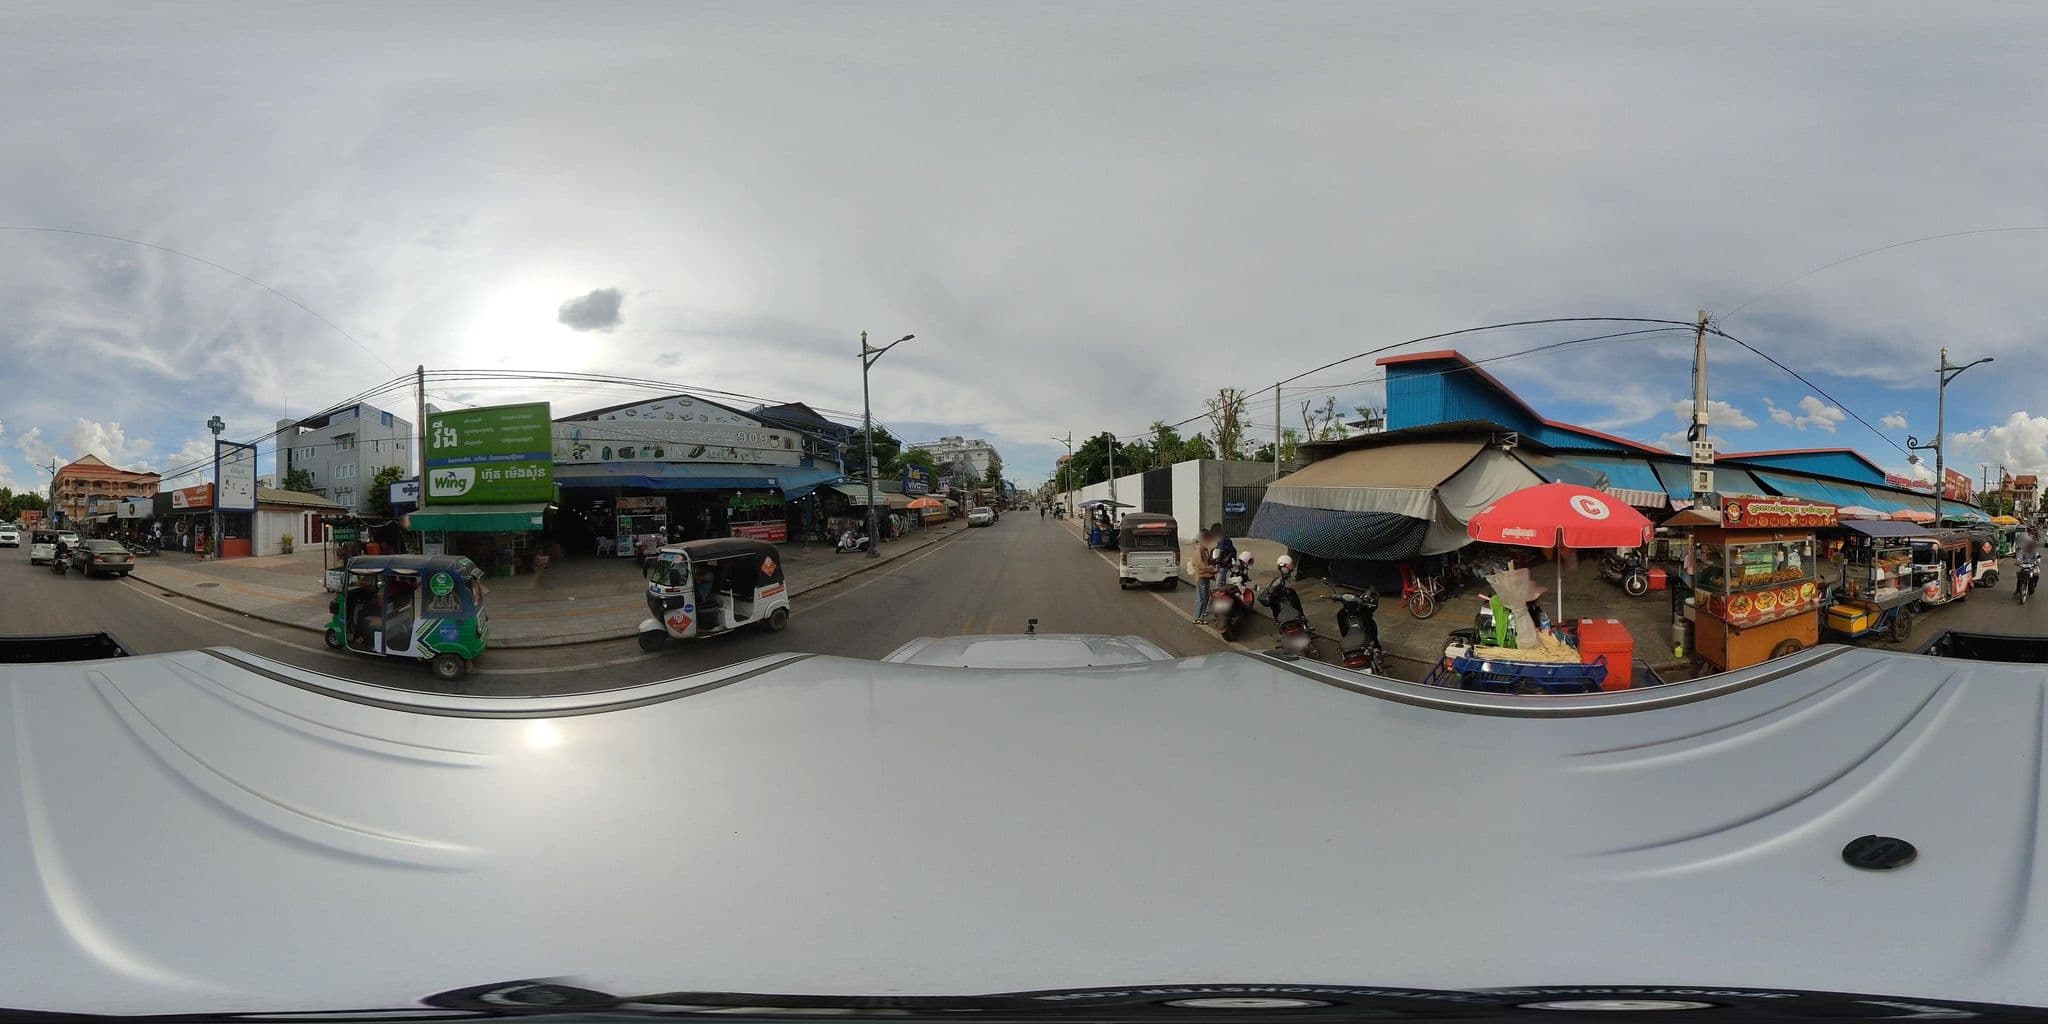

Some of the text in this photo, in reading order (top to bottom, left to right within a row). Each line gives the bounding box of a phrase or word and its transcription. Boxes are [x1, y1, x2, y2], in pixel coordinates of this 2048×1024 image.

[432, 420, 457, 449] វីង
[434, 477, 467, 492] Wing
[1579, 499, 1601, 515] C
